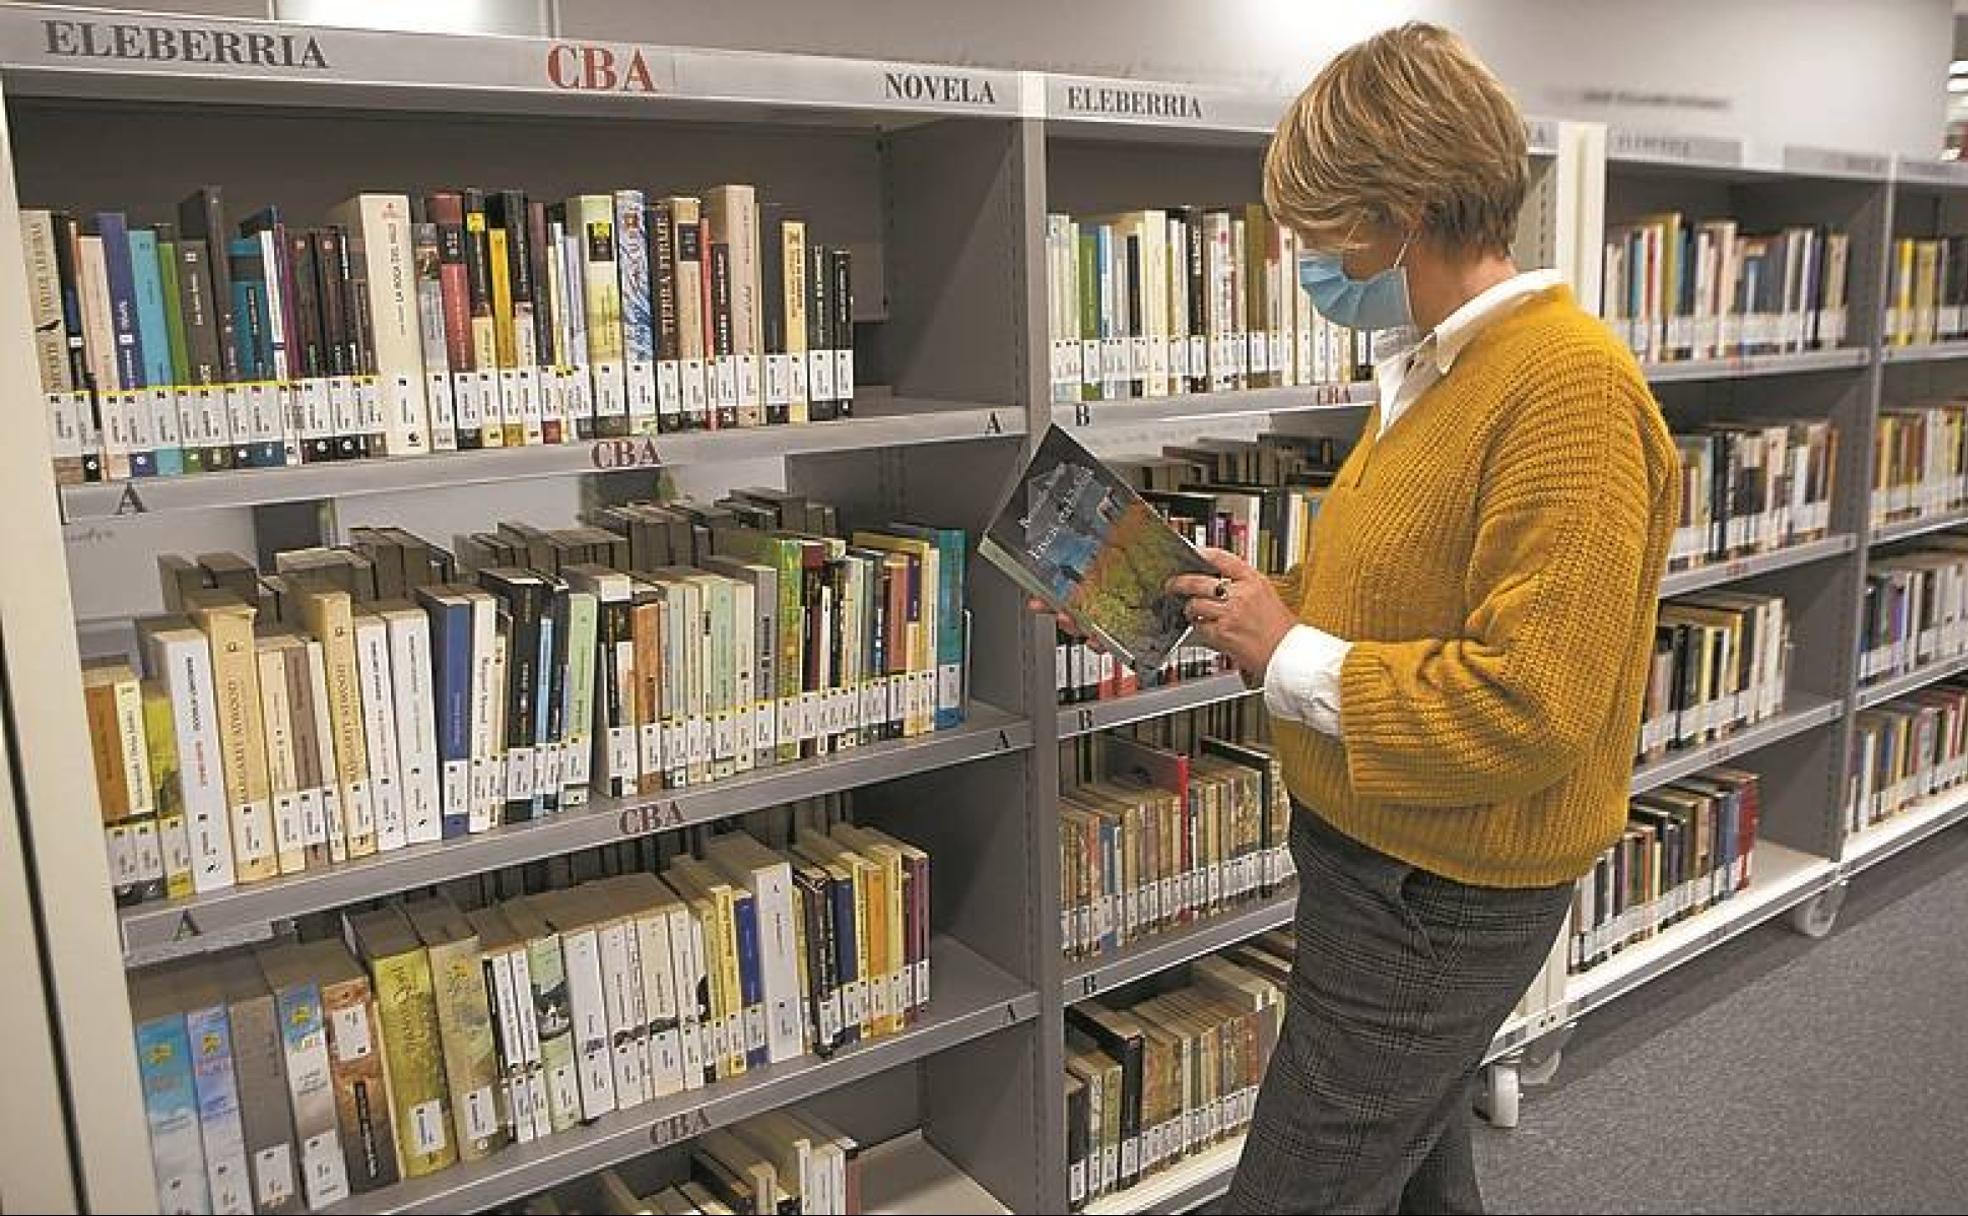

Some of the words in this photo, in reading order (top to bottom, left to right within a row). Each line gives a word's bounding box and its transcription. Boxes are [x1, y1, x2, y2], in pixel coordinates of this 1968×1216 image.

[41, 20, 328, 68] ELEBERRIA
[547, 45, 656, 91] CBA
[885, 73, 996, 104] NOVELA
[1068, 86, 1202, 118] ELEBERRIA
[984, 411, 1003, 434] A
[1075, 403, 1091, 427] B
[592, 438, 662, 469] CBA
[113, 481, 149, 515] A
[620, 800, 685, 834] CBA
[172, 907, 206, 942] A
[649, 1108, 712, 1145] CBA
